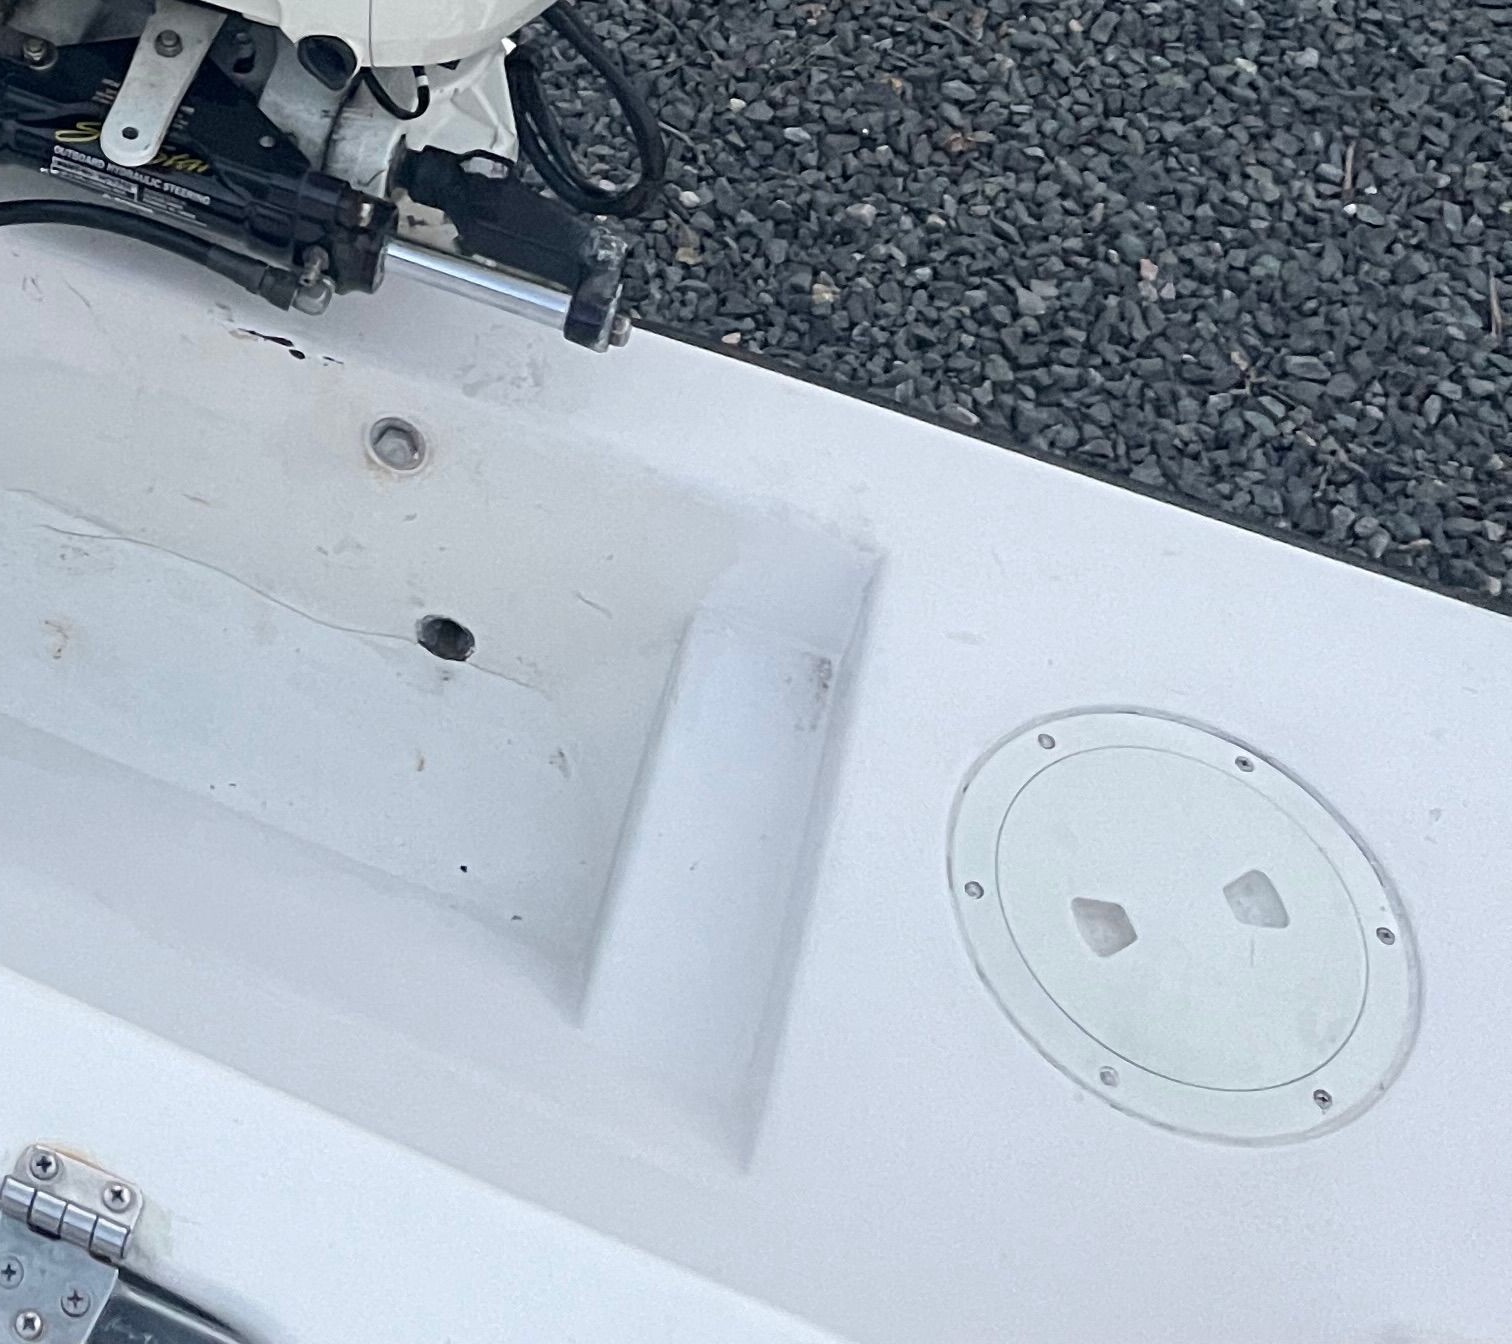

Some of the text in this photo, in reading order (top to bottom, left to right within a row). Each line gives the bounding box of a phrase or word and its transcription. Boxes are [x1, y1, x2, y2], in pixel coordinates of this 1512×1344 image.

[54, 145, 105, 169] OUTBOARD
[106, 163, 162, 189] HYDRAULIC
[163, 182, 211, 205] STEERING
